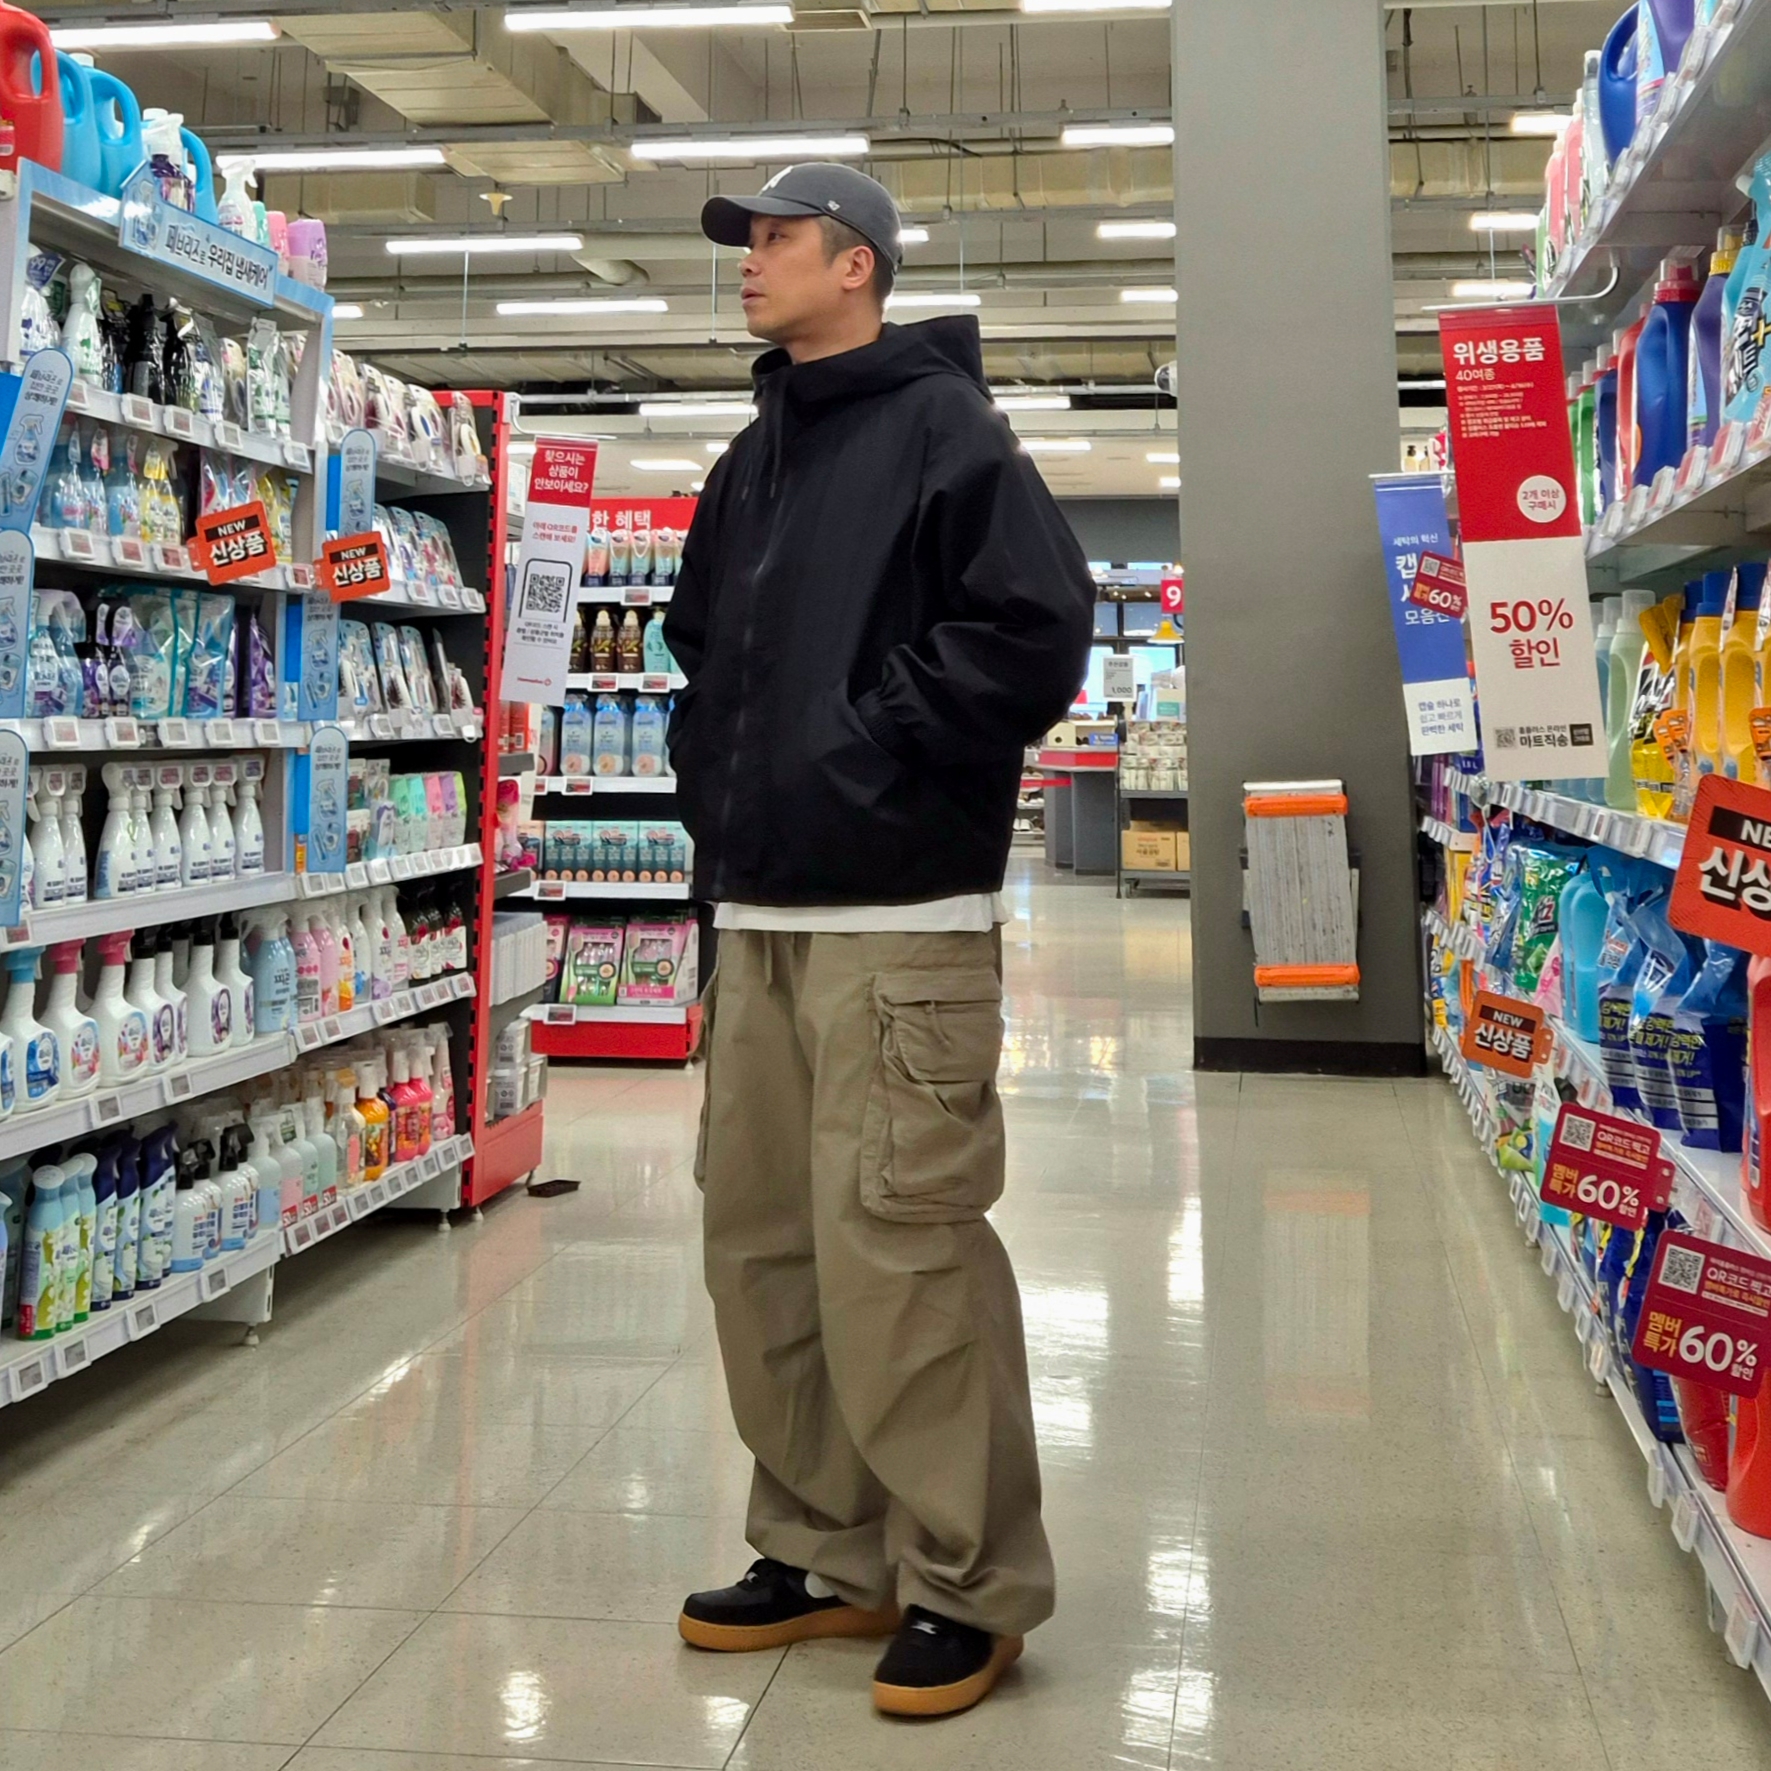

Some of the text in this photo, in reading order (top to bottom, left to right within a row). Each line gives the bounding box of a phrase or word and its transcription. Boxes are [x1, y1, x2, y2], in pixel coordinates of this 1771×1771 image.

[1453, 337, 1545, 365] 위생용품
[1455, 368, 1496, 381] 40여종
[544, 449, 586, 466] 찾으시는
[548, 464, 579, 480] 상품이
[534, 478, 589, 494] 안보이세요?
[1522, 488, 1559, 500] 2개 이상
[1528, 500, 1557, 511] 구매시
[217, 519, 246, 537] NEW
[615, 509, 651, 531] 혜택
[209, 530, 266, 567] 신상품
[1393, 532, 1439, 547] 세탁의 혁신
[340, 546, 366, 560] NEW
[332, 557, 382, 587] 신상품
[1395, 553, 1418, 579] 캡
[1166, 585, 1182, 608] 9
[1490, 598, 1573, 634] 50%
[1509, 637, 1561, 669] 할인
[1519, 733, 1568, 748] 마트직송
[1740, 819, 1771, 849] NE
[1698, 846, 1771, 911] 신상
[1493, 1010, 1523, 1028] NEW
[1474, 1022, 1532, 1060] 신상품
[1553, 1163, 1579, 1184] 멤버
[1549, 1178, 1576, 1199] 특가
[1577, 1175, 1640, 1210] 60%
[1707, 1267, 1750, 1290] QR코드
[1649, 1311, 1682, 1338] 멤버
[1643, 1330, 1677, 1358] 특가
[1679, 1325, 1758, 1372] 60%
[1730, 1363, 1754, 1381] 할인
